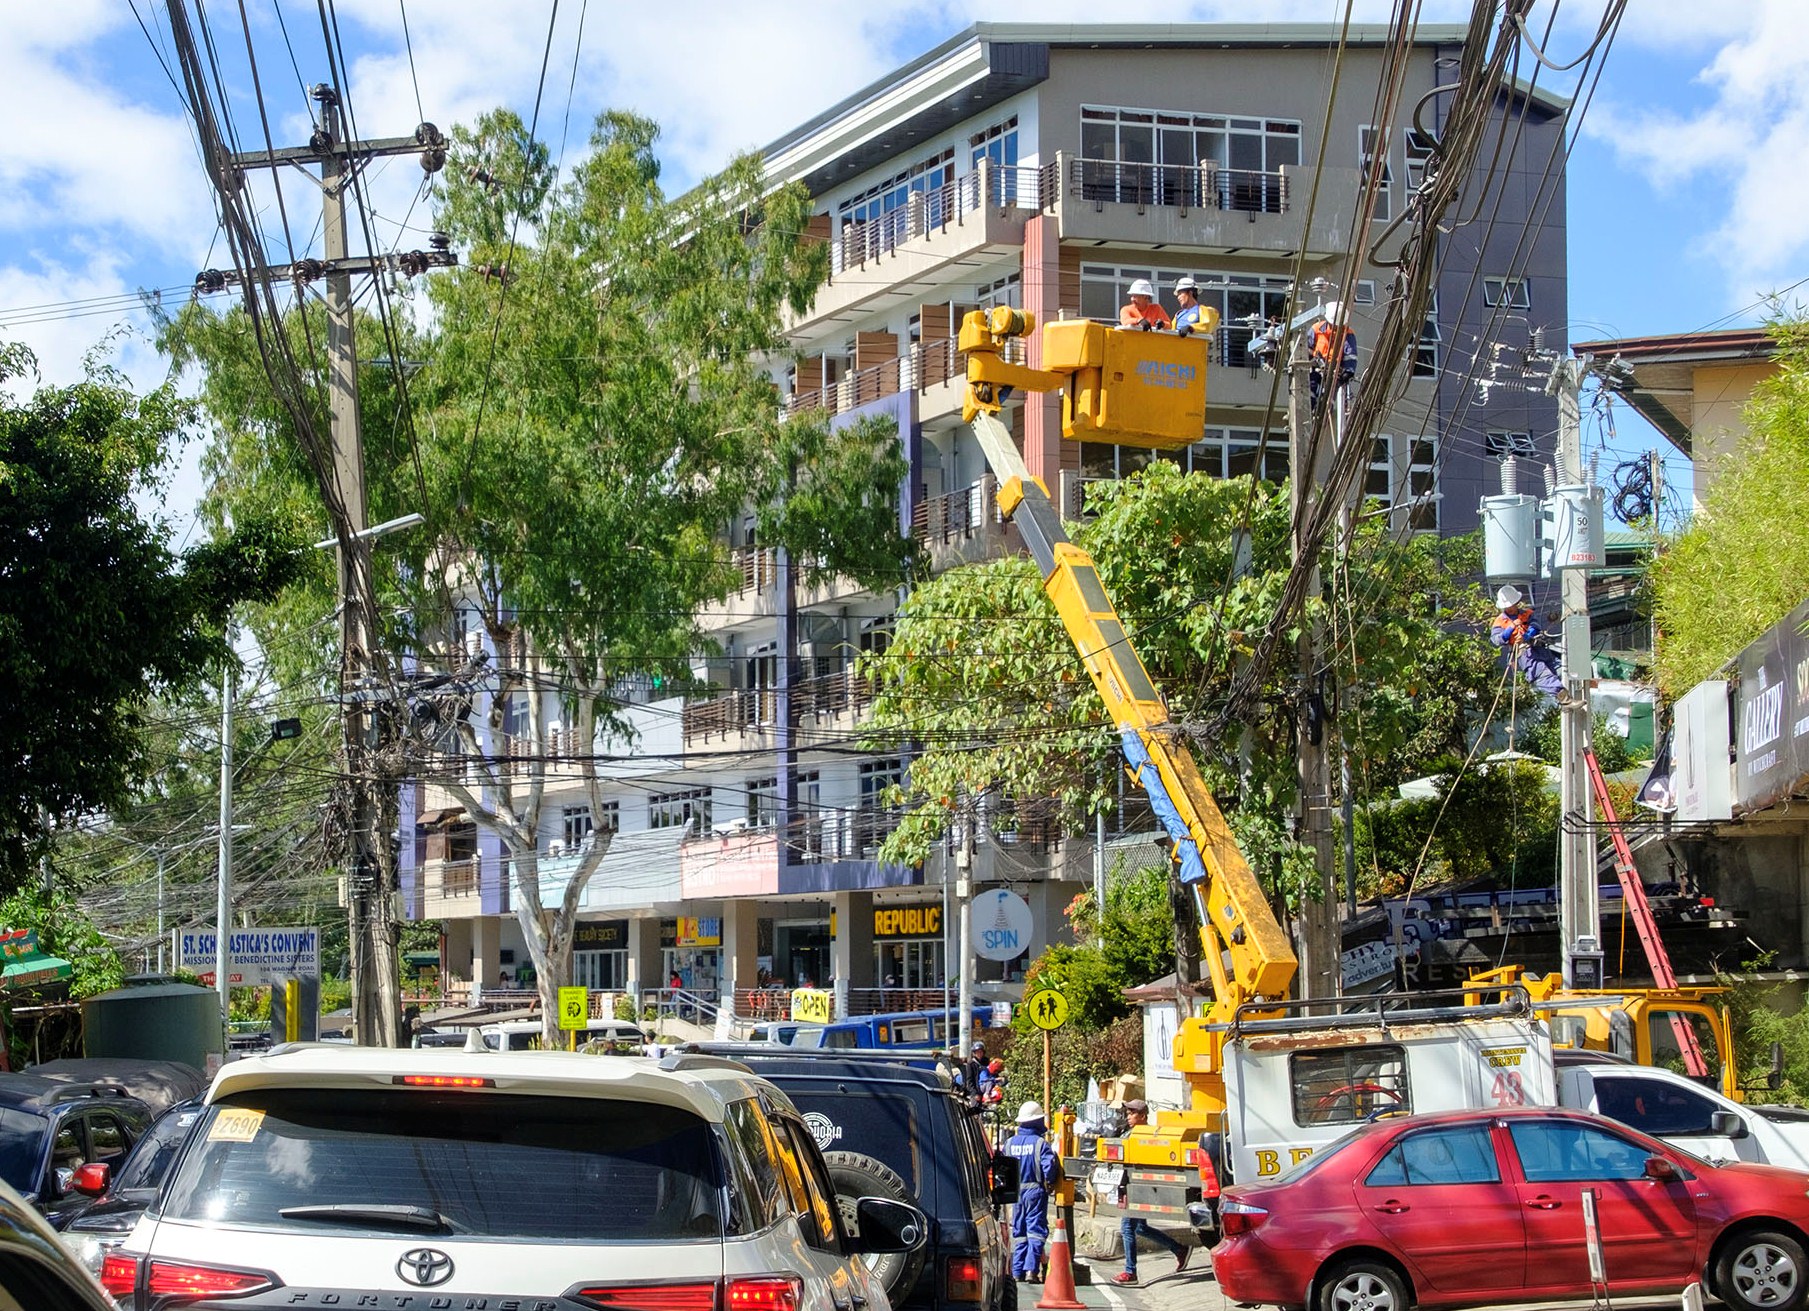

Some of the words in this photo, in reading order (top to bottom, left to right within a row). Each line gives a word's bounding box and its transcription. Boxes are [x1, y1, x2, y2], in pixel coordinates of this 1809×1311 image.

[1145, 361, 1196, 380] AICHI
[1577, 517, 1588, 526] 50
[1745, 681, 1783, 755] GALLERY
[874, 907, 939, 935] REPUBLIC
[183, 934, 196, 954] ST.
[198, 933, 269, 954] SCHASTICA'S
[271, 933, 315, 953] CONVENT
[985, 929, 1018, 949] SPIN
[234, 955, 285, 964] BENEDICTINE
[286, 954, 315, 963] SISTERS
[802, 994, 827, 1017] OPEN
[1489, 1055, 1521, 1068] CREW
[1491, 1071, 1525, 1107] 43
[288, 1293, 556, 1311] FORTUNER
